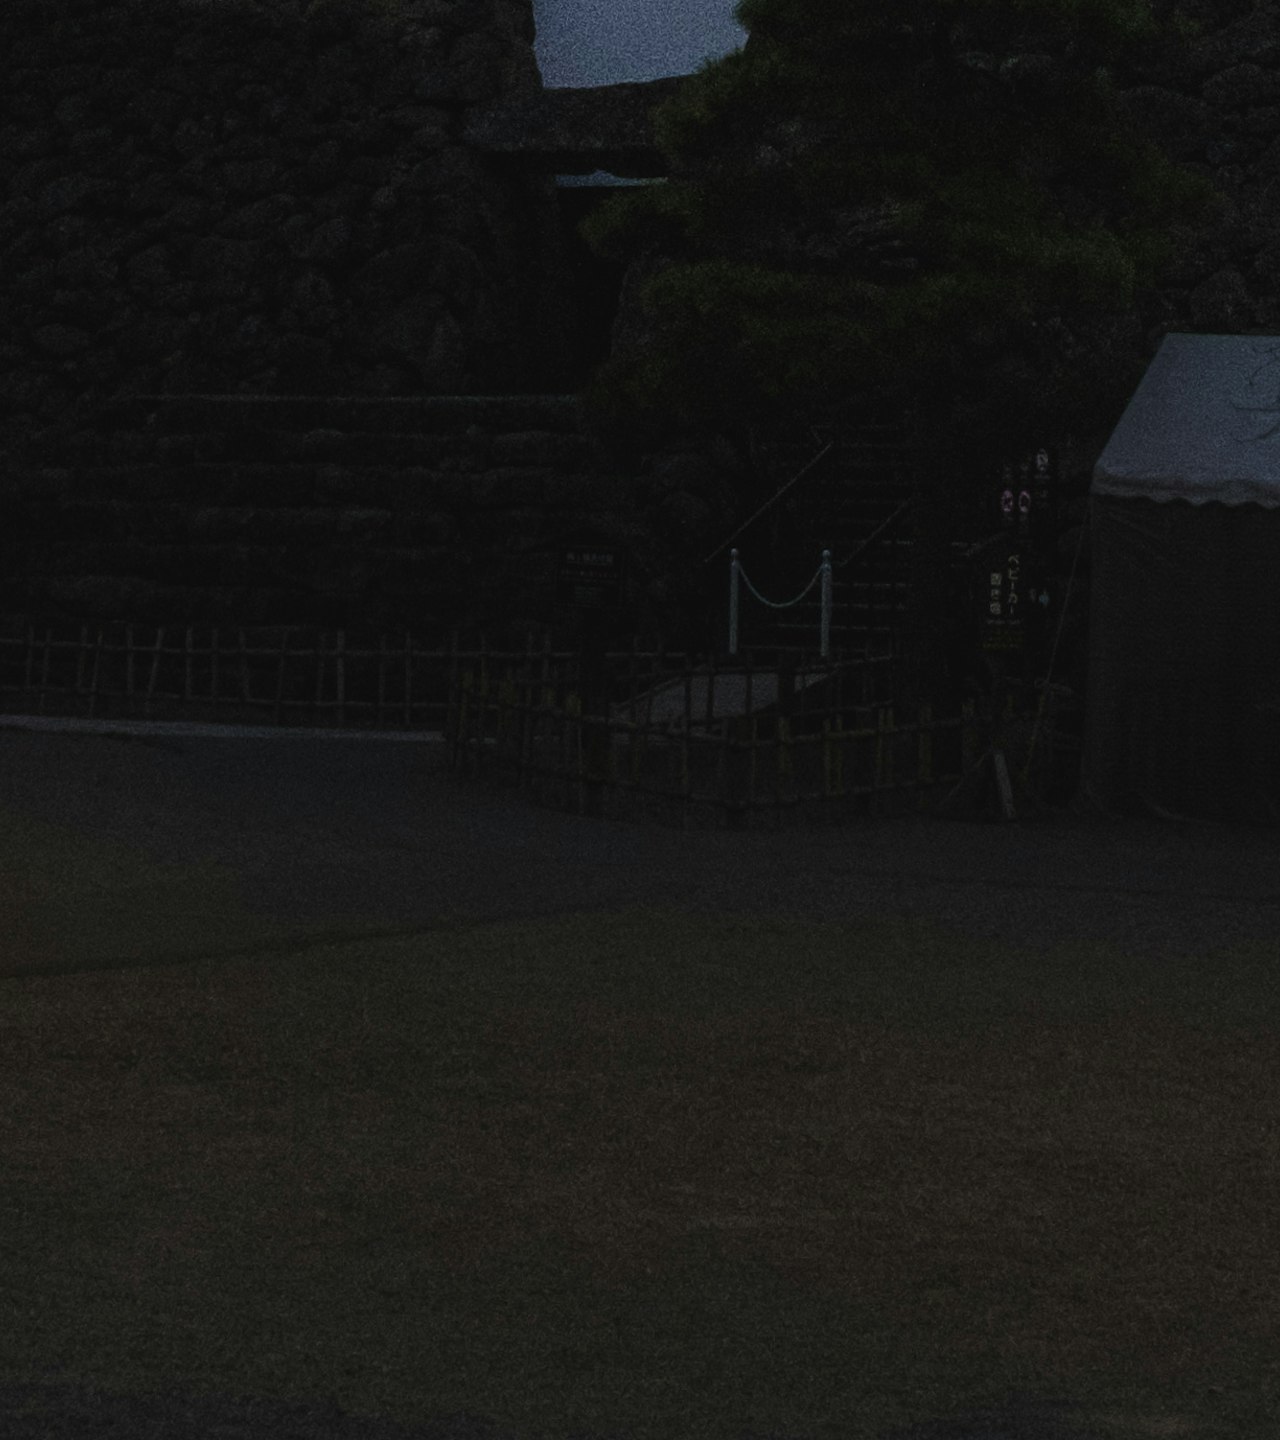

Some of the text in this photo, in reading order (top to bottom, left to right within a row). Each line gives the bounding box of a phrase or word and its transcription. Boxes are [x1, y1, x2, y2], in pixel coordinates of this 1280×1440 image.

[1008, 554, 1020, 614] ベビーカー
